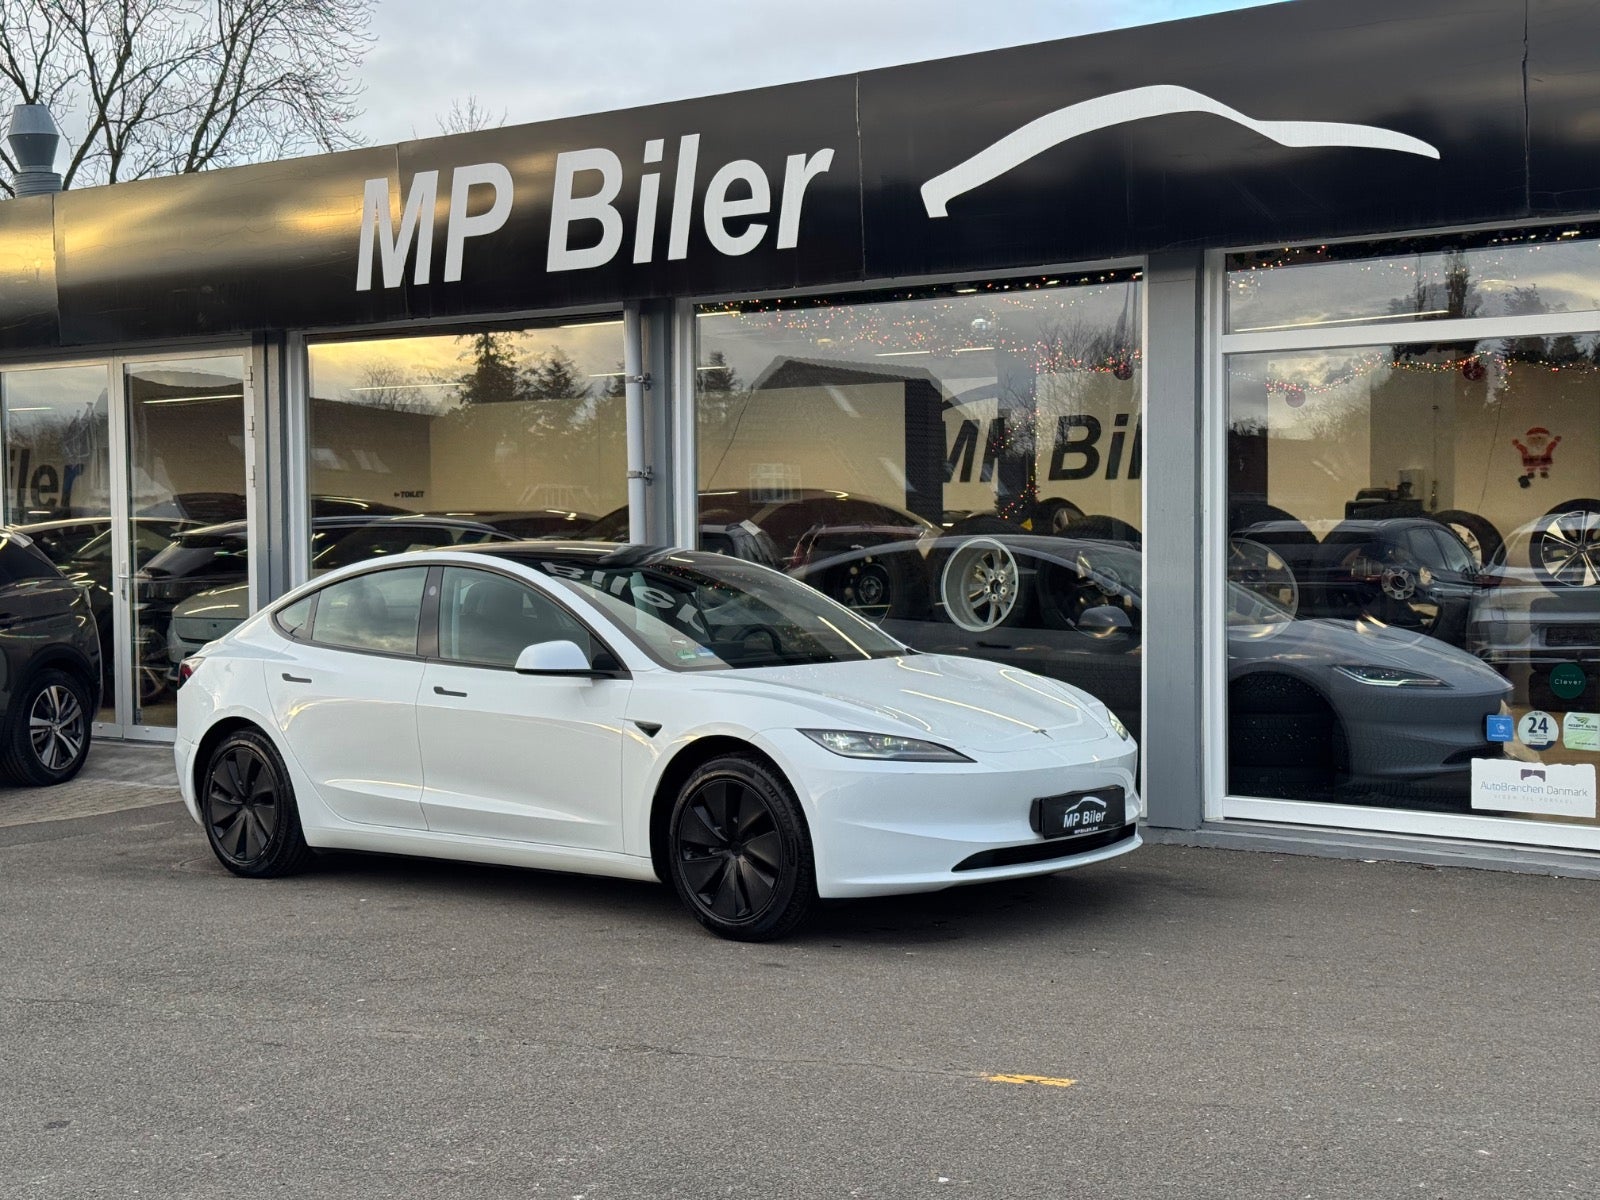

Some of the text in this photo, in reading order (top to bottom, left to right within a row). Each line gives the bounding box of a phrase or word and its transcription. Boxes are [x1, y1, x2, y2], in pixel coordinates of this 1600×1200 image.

[355, 133, 835, 291] MP Biler
[1554, 678, 1582, 686] Clever
[1528, 716, 1548, 734] 24
[1480, 781, 1588, 797] AutoBranchen Danmark
[1063, 810, 1106, 828] MP Biler
